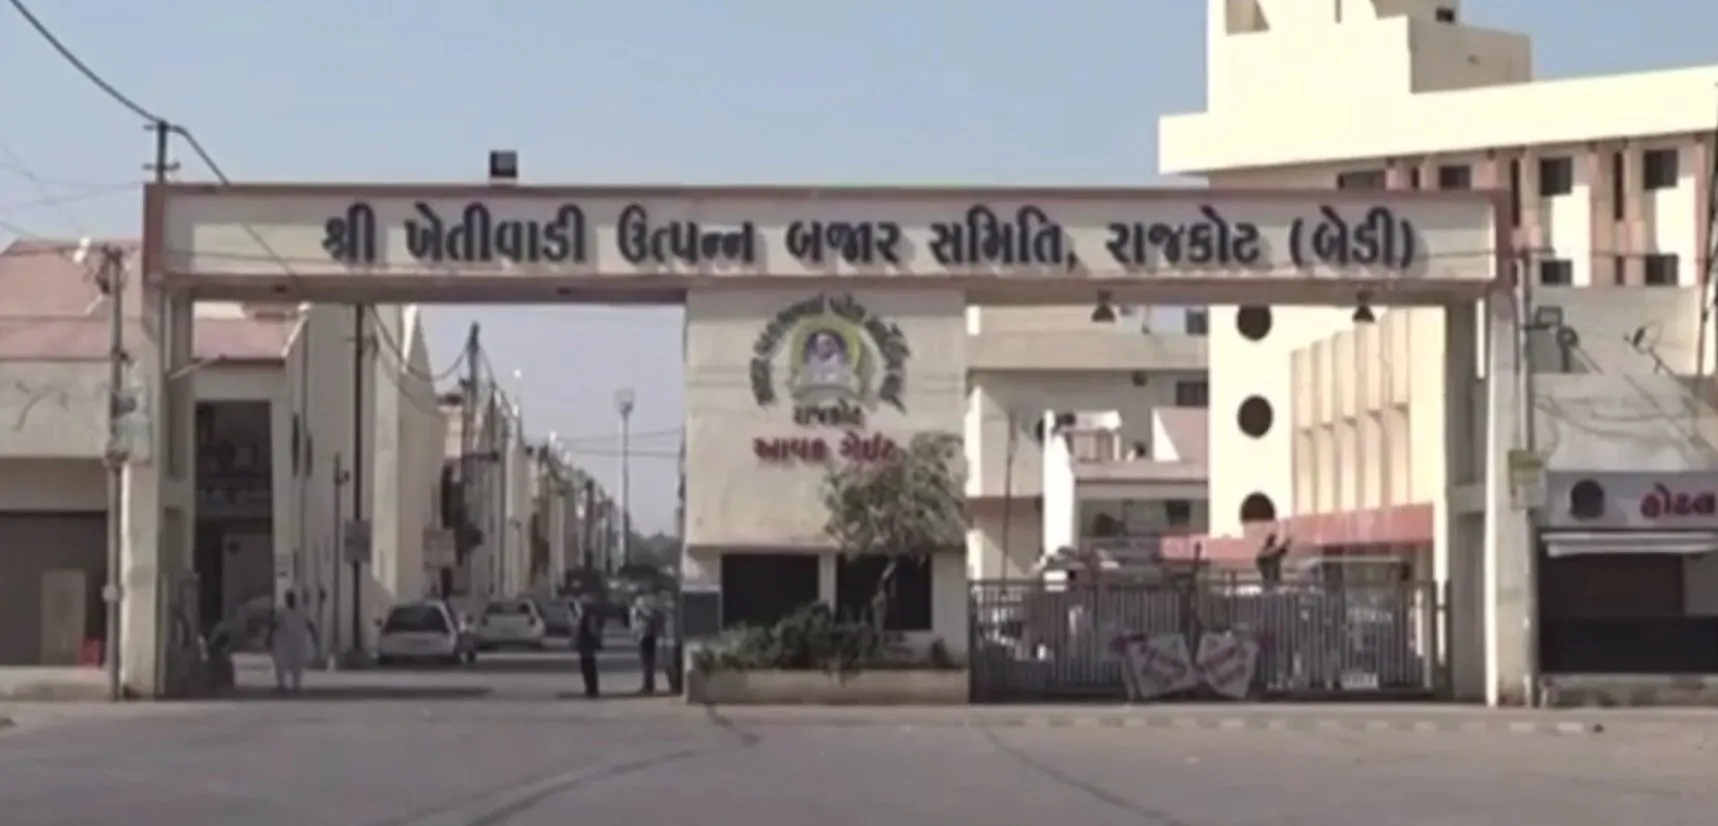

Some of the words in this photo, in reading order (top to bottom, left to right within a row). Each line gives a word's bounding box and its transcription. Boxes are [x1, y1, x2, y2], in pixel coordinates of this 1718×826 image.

[321, 203, 376, 264] શ્રી
[403, 202, 587, 264] ખેતીવાડી
[616, 204, 756, 265] ઉત્પન્ન
[785, 220, 899, 265] બજાર
[1105, 205, 1262, 268] રાજકોટ
